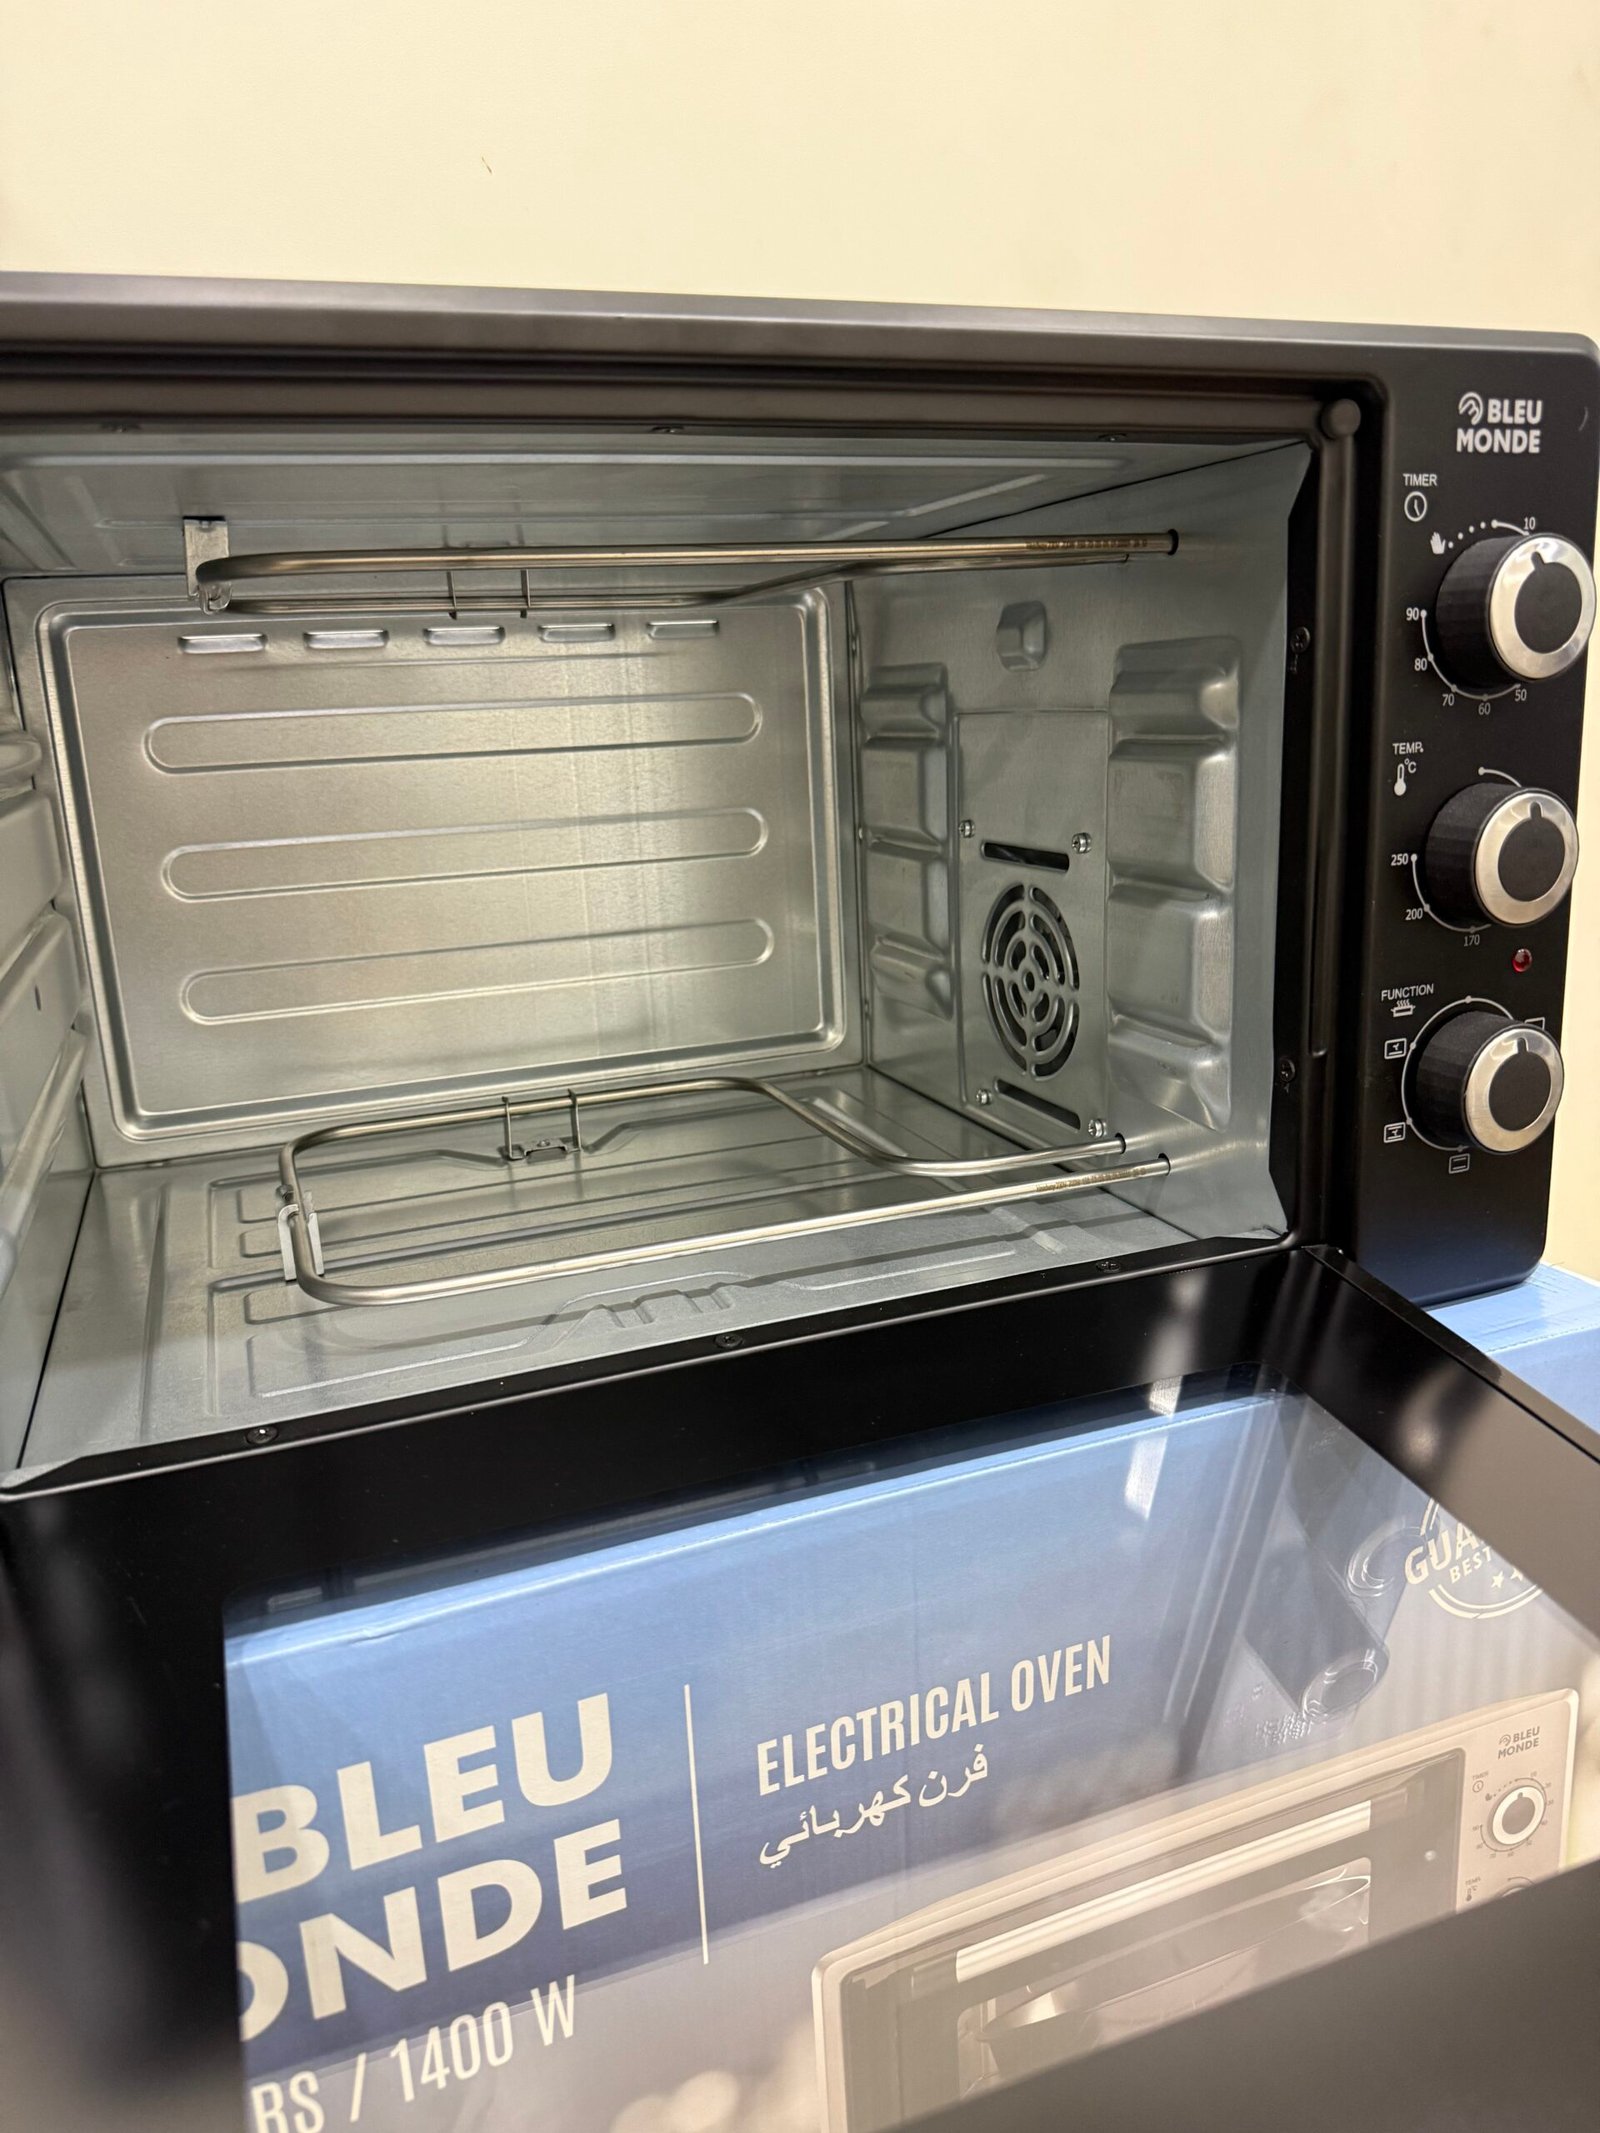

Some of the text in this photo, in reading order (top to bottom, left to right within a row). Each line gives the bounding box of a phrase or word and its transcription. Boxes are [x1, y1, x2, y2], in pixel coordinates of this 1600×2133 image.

[1487, 398, 1543, 424] BLEU
[1456, 428, 1541, 453] MONDE
[1403, 473, 1437, 486] TIMER
[1523, 517, 1536, 530] 10
[1406, 607, 1419, 621] 90
[1414, 658, 1427, 671] 80
[1442, 694, 1454, 706] 70
[1515, 689, 1527, 701] 50
[1478, 703, 1490, 715] 60
[1390, 853, 1409, 866] 250
[1405, 908, 1423, 920] 200
[1464, 934, 1480, 946] 170
[1381, 984, 1434, 1001] FUNCTION
[1450, 1546, 1491, 1584] BEST
[757, 1634, 1111, 1796] ELECTRICAL OVEN
[1513, 1726, 1540, 1743] BLEU
[1498, 1737, 1540, 1760] MONDE
[232, 1693, 613, 1904] BLEU
[759, 1743, 988, 1868] فرن كهربائي
[252, 2070, 325, 2133] RS
[390, 2001, 514, 2102] 1400
[531, 1974, 576, 2047] W
